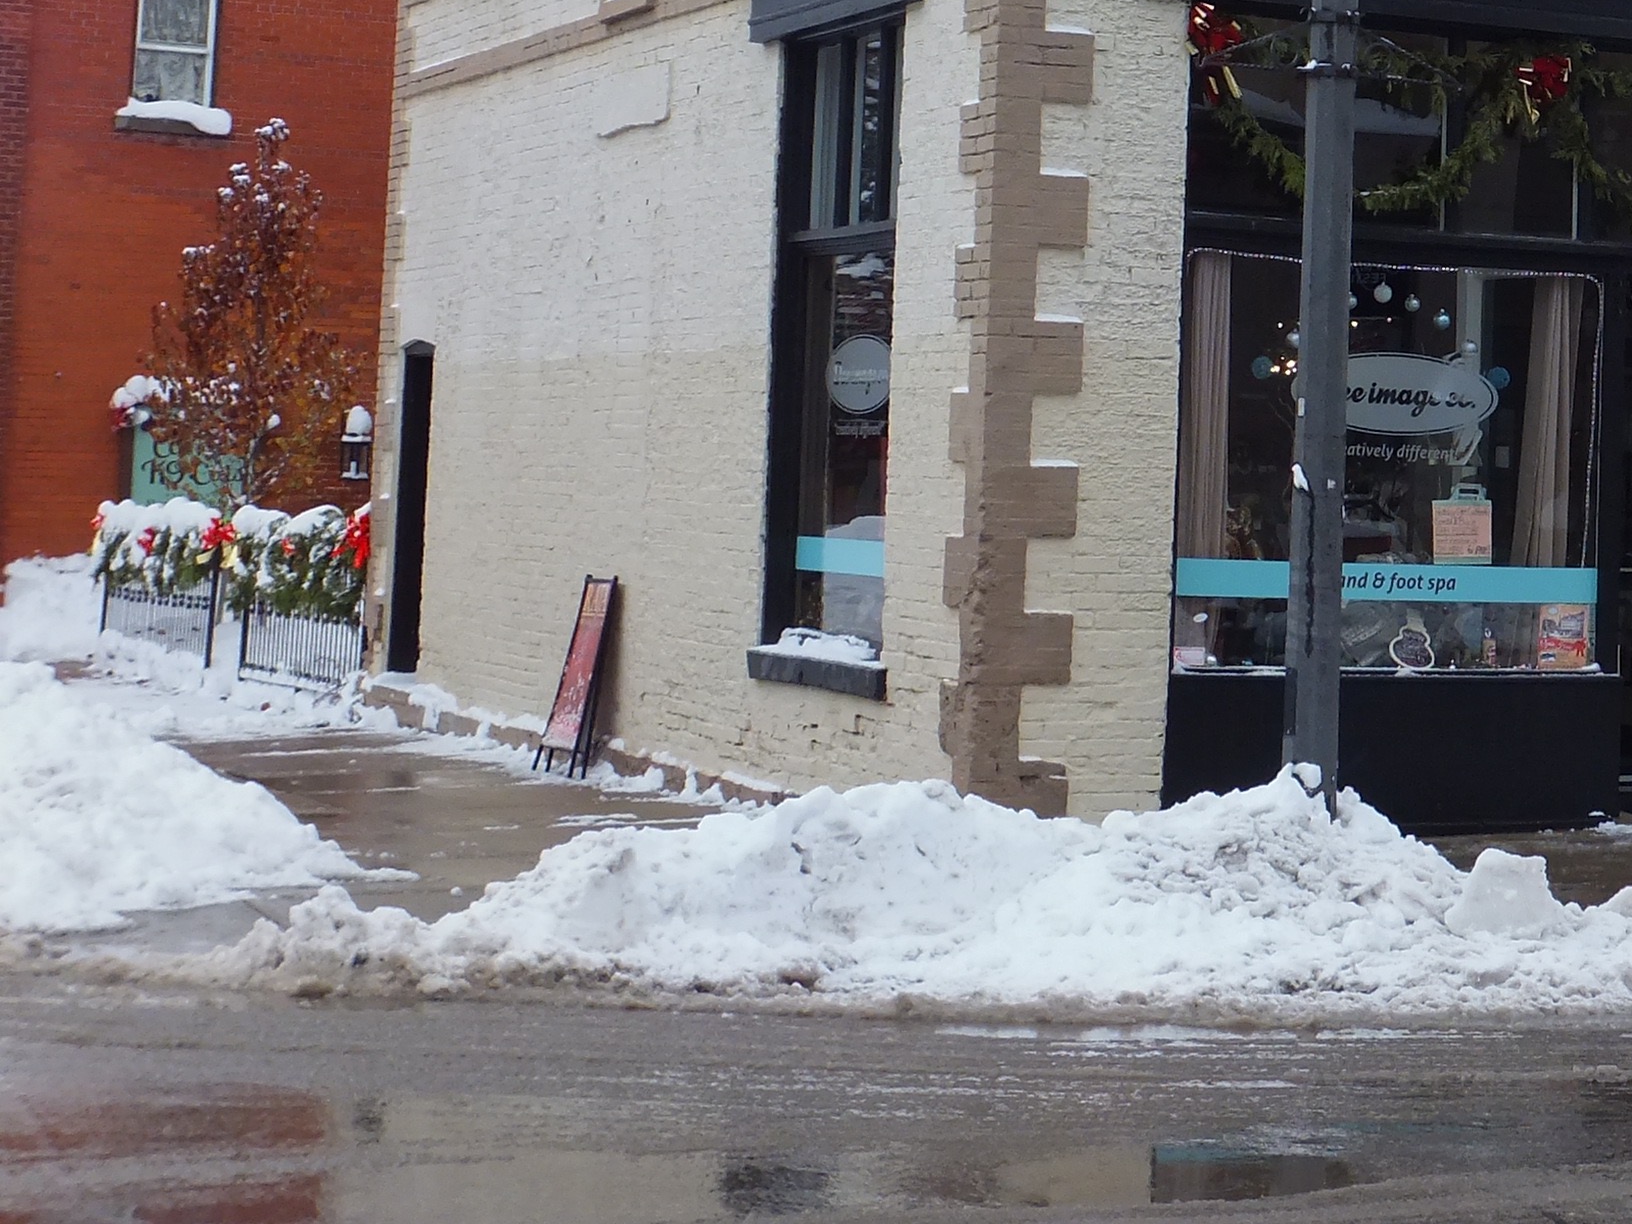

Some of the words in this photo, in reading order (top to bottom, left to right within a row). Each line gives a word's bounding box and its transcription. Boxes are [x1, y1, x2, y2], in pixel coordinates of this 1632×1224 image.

[1345, 442, 1394, 462] atively
[1396, 443, 1461, 463] different!
[1372, 572, 1386, 589] &
[1387, 572, 1424, 594] foot
[1427, 576, 1456, 595] spa
